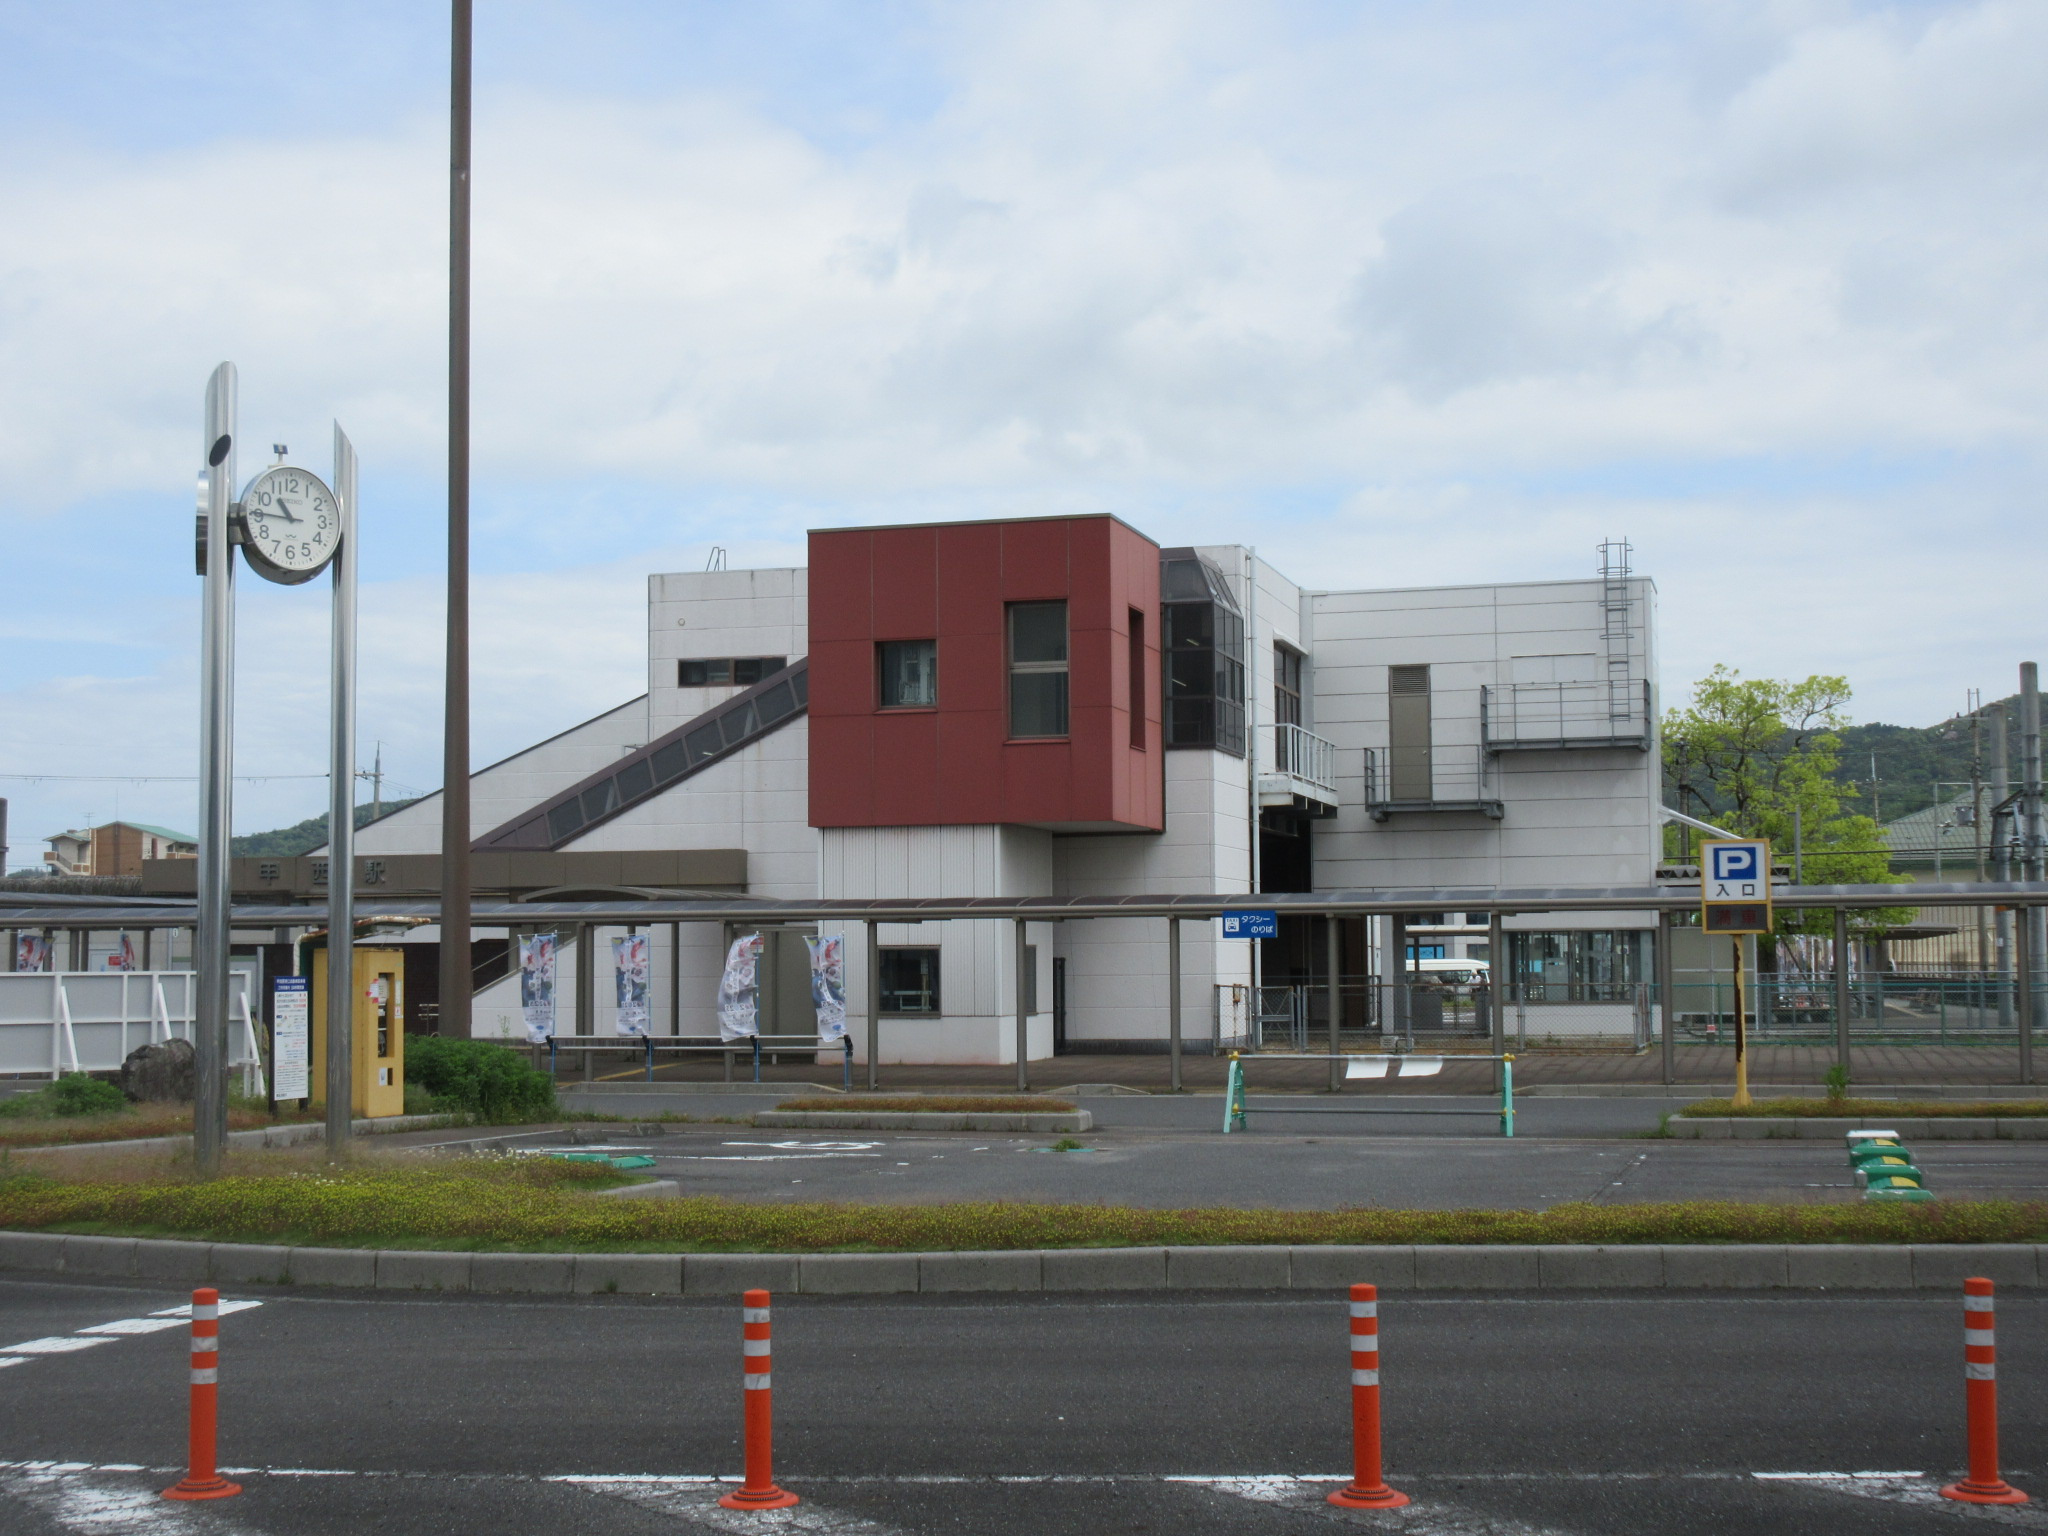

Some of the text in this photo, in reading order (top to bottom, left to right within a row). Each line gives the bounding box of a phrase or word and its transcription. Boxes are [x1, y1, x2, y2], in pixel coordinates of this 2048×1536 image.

[272, 480, 282, 495] 11
[285, 478, 299, 494] 12
[258, 491, 271, 506] 10
[313, 497, 323, 512] 2
[254, 508, 264, 523] 9
[317, 514, 327, 530] 3
[259, 524, 269, 540] 8
[312, 531, 323, 546] 4
[271, 539, 281, 554] 7
[285, 544, 295, 560] 6
[301, 542, 311, 557] 5
[1718, 849, 1751, 878] P
[1716, 883, 1755, 897] 入口
[1241, 915, 1271, 924] タクシー
[1250, 925, 1274, 934] のりば
